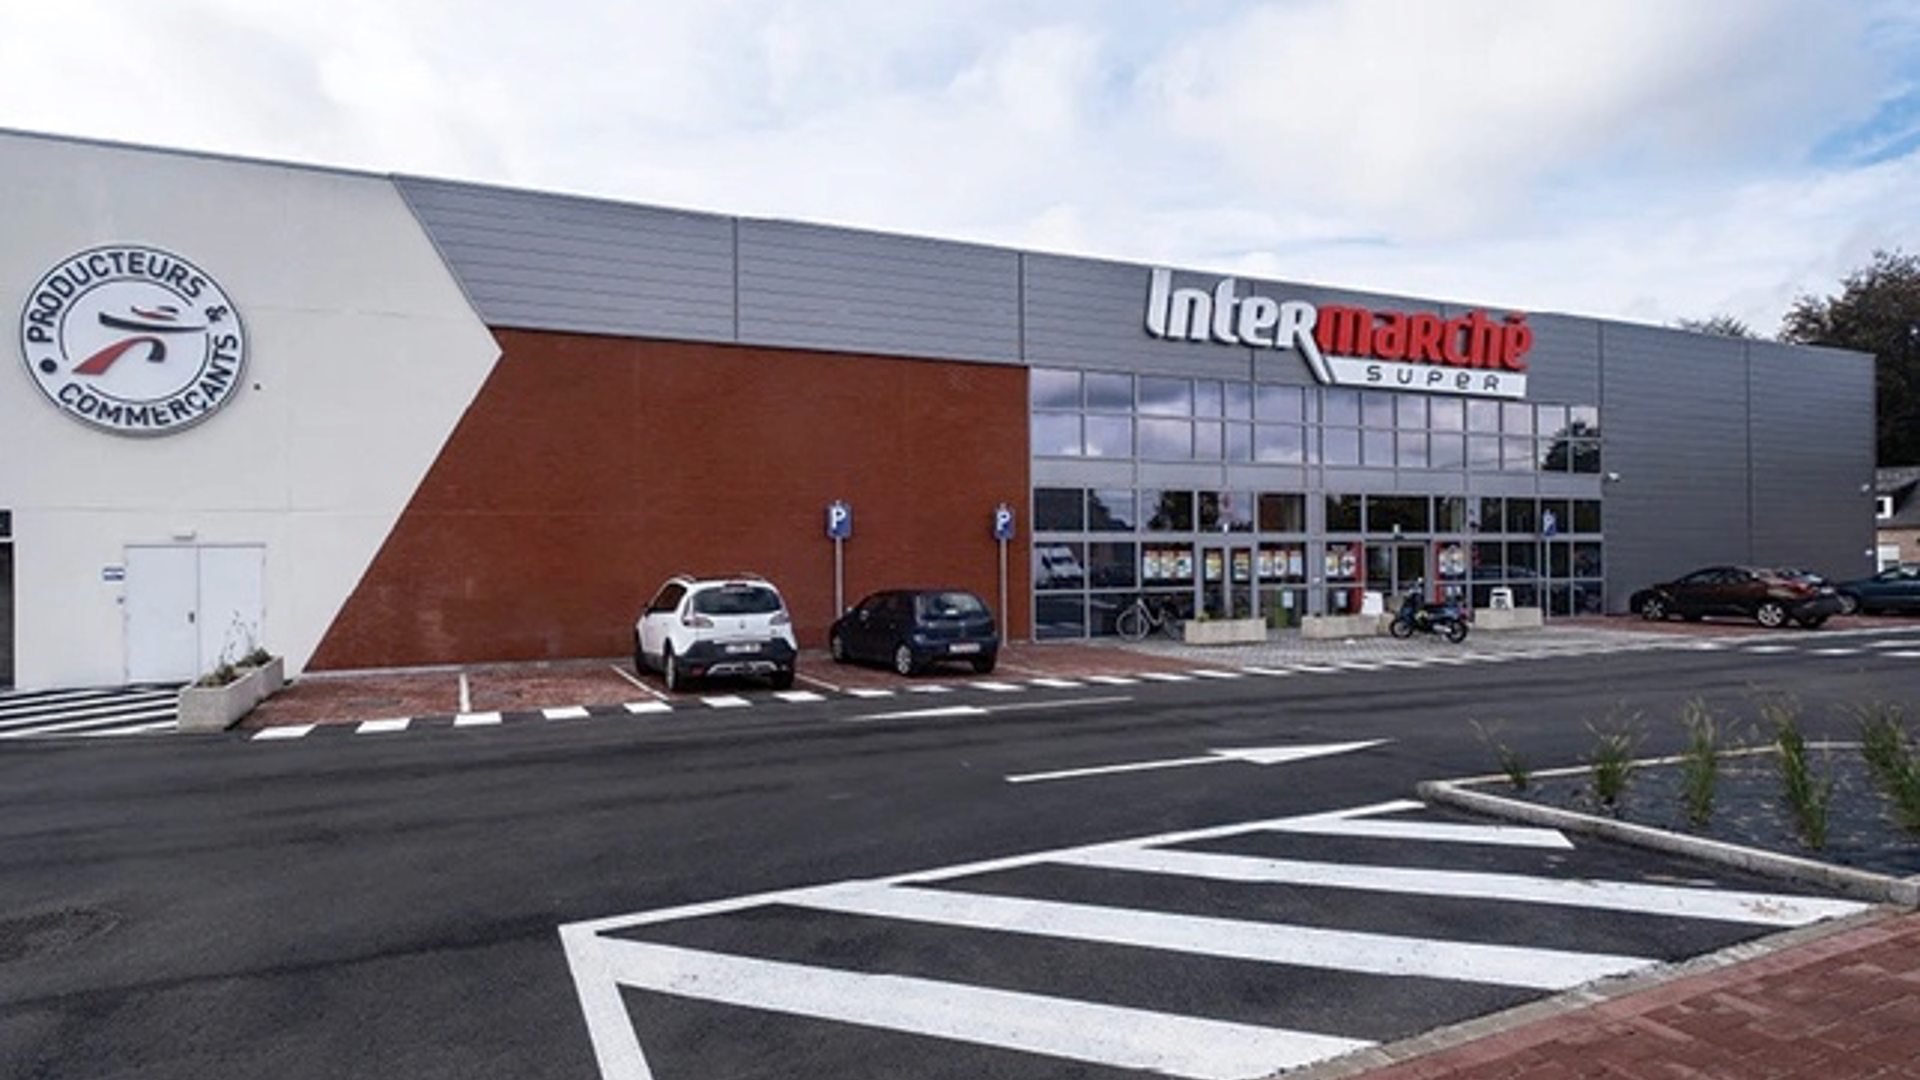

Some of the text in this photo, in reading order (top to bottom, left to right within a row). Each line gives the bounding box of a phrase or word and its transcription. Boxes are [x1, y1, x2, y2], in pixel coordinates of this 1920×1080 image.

[27, 252, 207, 343] PRODUCTEURS
[205, 304, 228, 323] &
[830, 507, 847, 530] P
[996, 511, 1011, 531] P
